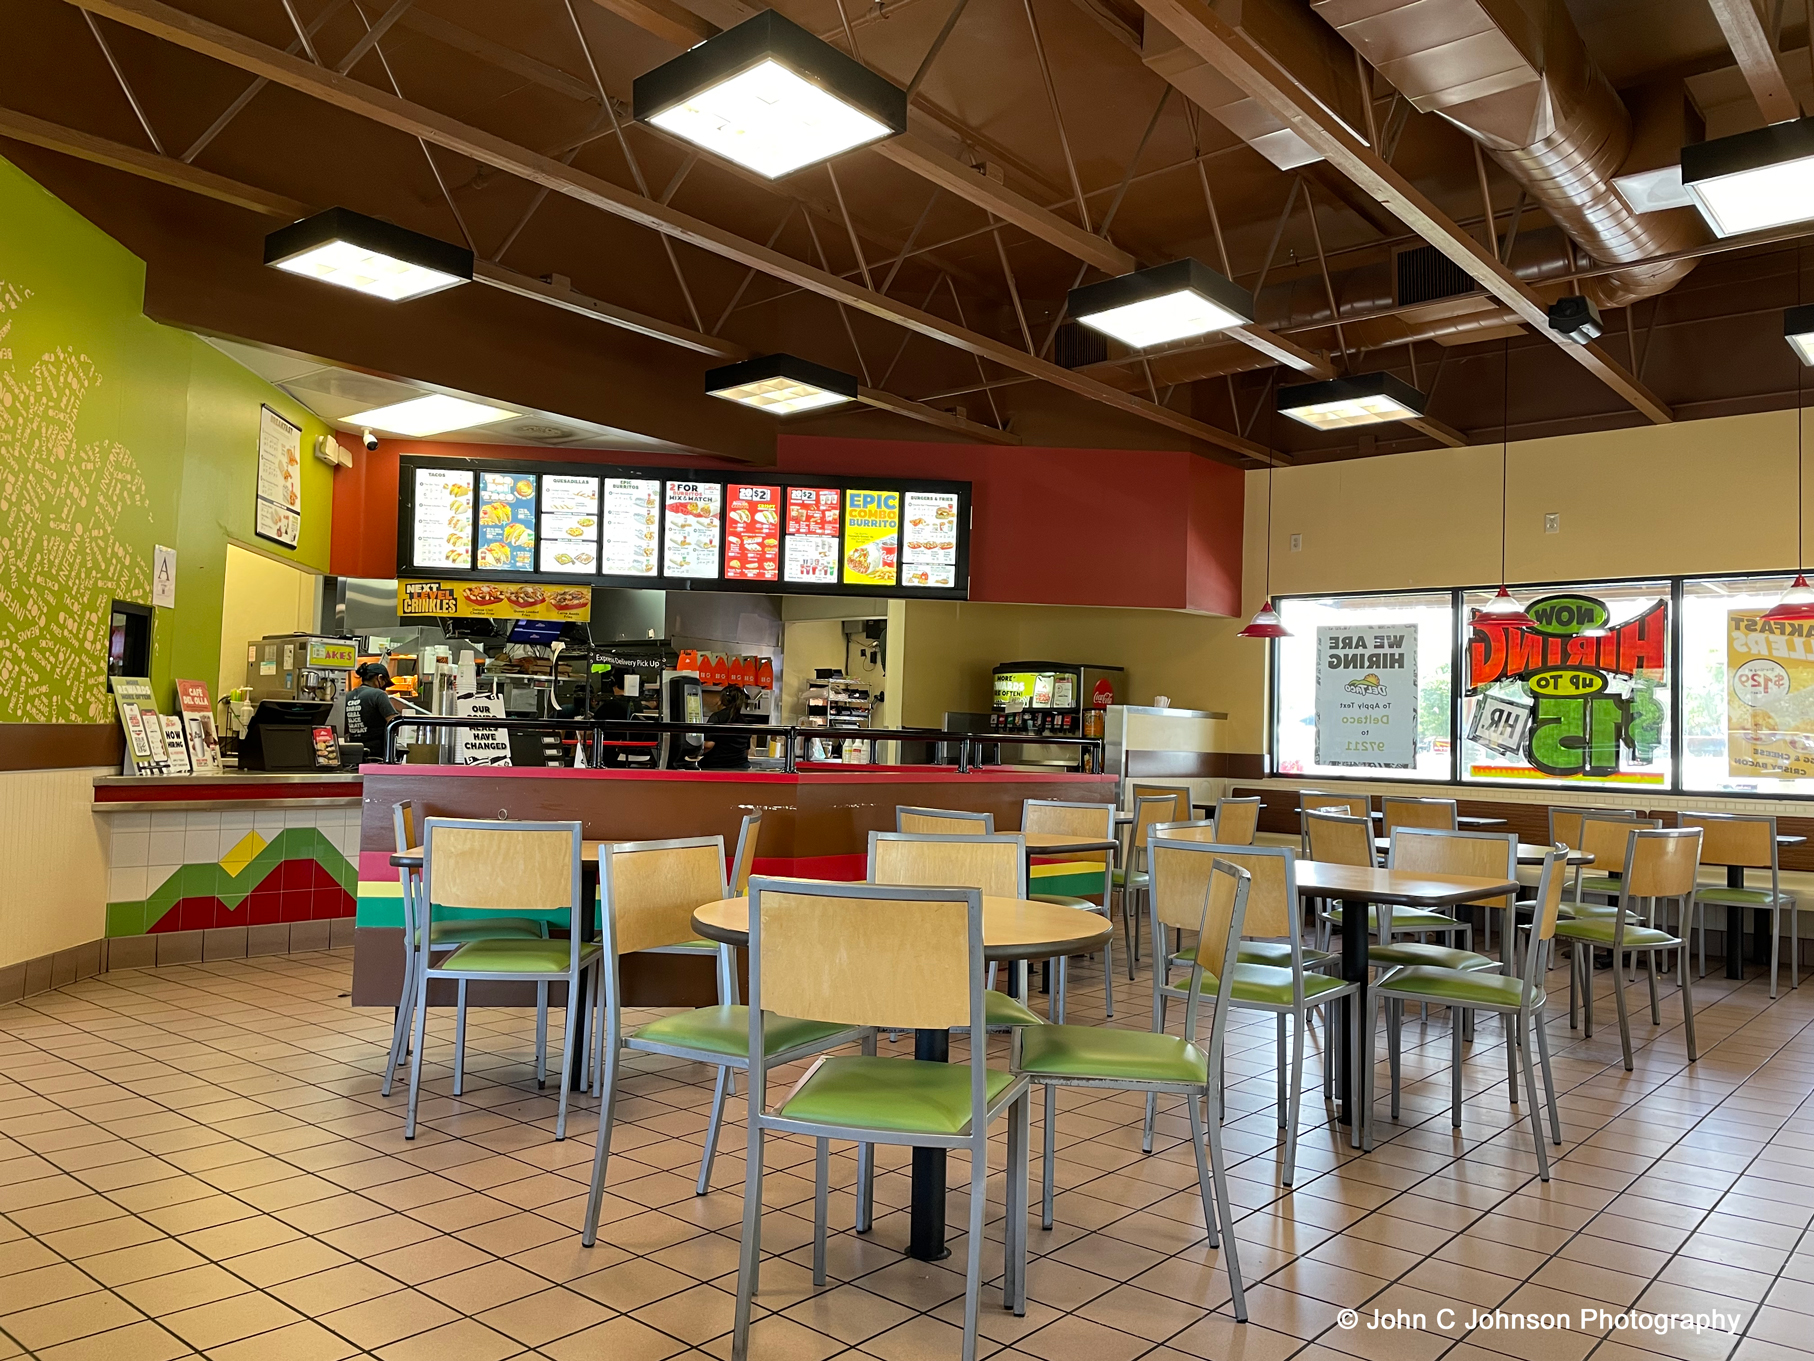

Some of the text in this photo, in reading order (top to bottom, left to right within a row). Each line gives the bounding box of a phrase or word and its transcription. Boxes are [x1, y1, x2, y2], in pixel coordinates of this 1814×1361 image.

[669, 483, 699, 492] 2 FOR
[849, 493, 897, 510] EPIC
[849, 508, 897, 520] COMBO
[849, 518, 897, 528] BURRITO
[58, 522, 84, 585] INFERNO
[84, 532, 92, 567] BEANS
[7, 549, 18, 589] BEANS
[28, 553, 41, 584] MACHO
[158, 556, 170, 581] A
[406, 584, 439, 593] NEXT
[413, 591, 452, 600] LEVEL
[63, 593, 82, 615] TACOS
[403, 599, 456, 613] CRINKLES
[27, 598, 46, 627] BOLD
[18, 626, 39, 643] BEANS
[325, 650, 352, 660] AKES
[53, 644, 66, 679] TACOS
[636, 659, 649, 667] Pick
[650, 660, 660, 668] Up
[117, 685, 151, 694] REWARDS
[188, 687, 203, 697] CAFÉ
[183, 696, 208, 705] DEL OLLA
[472, 705, 490, 713] OUR
[165, 730, 181, 740] NOW
[473, 733, 497, 741] HAVE
[464, 742, 507, 750] CHANGED
